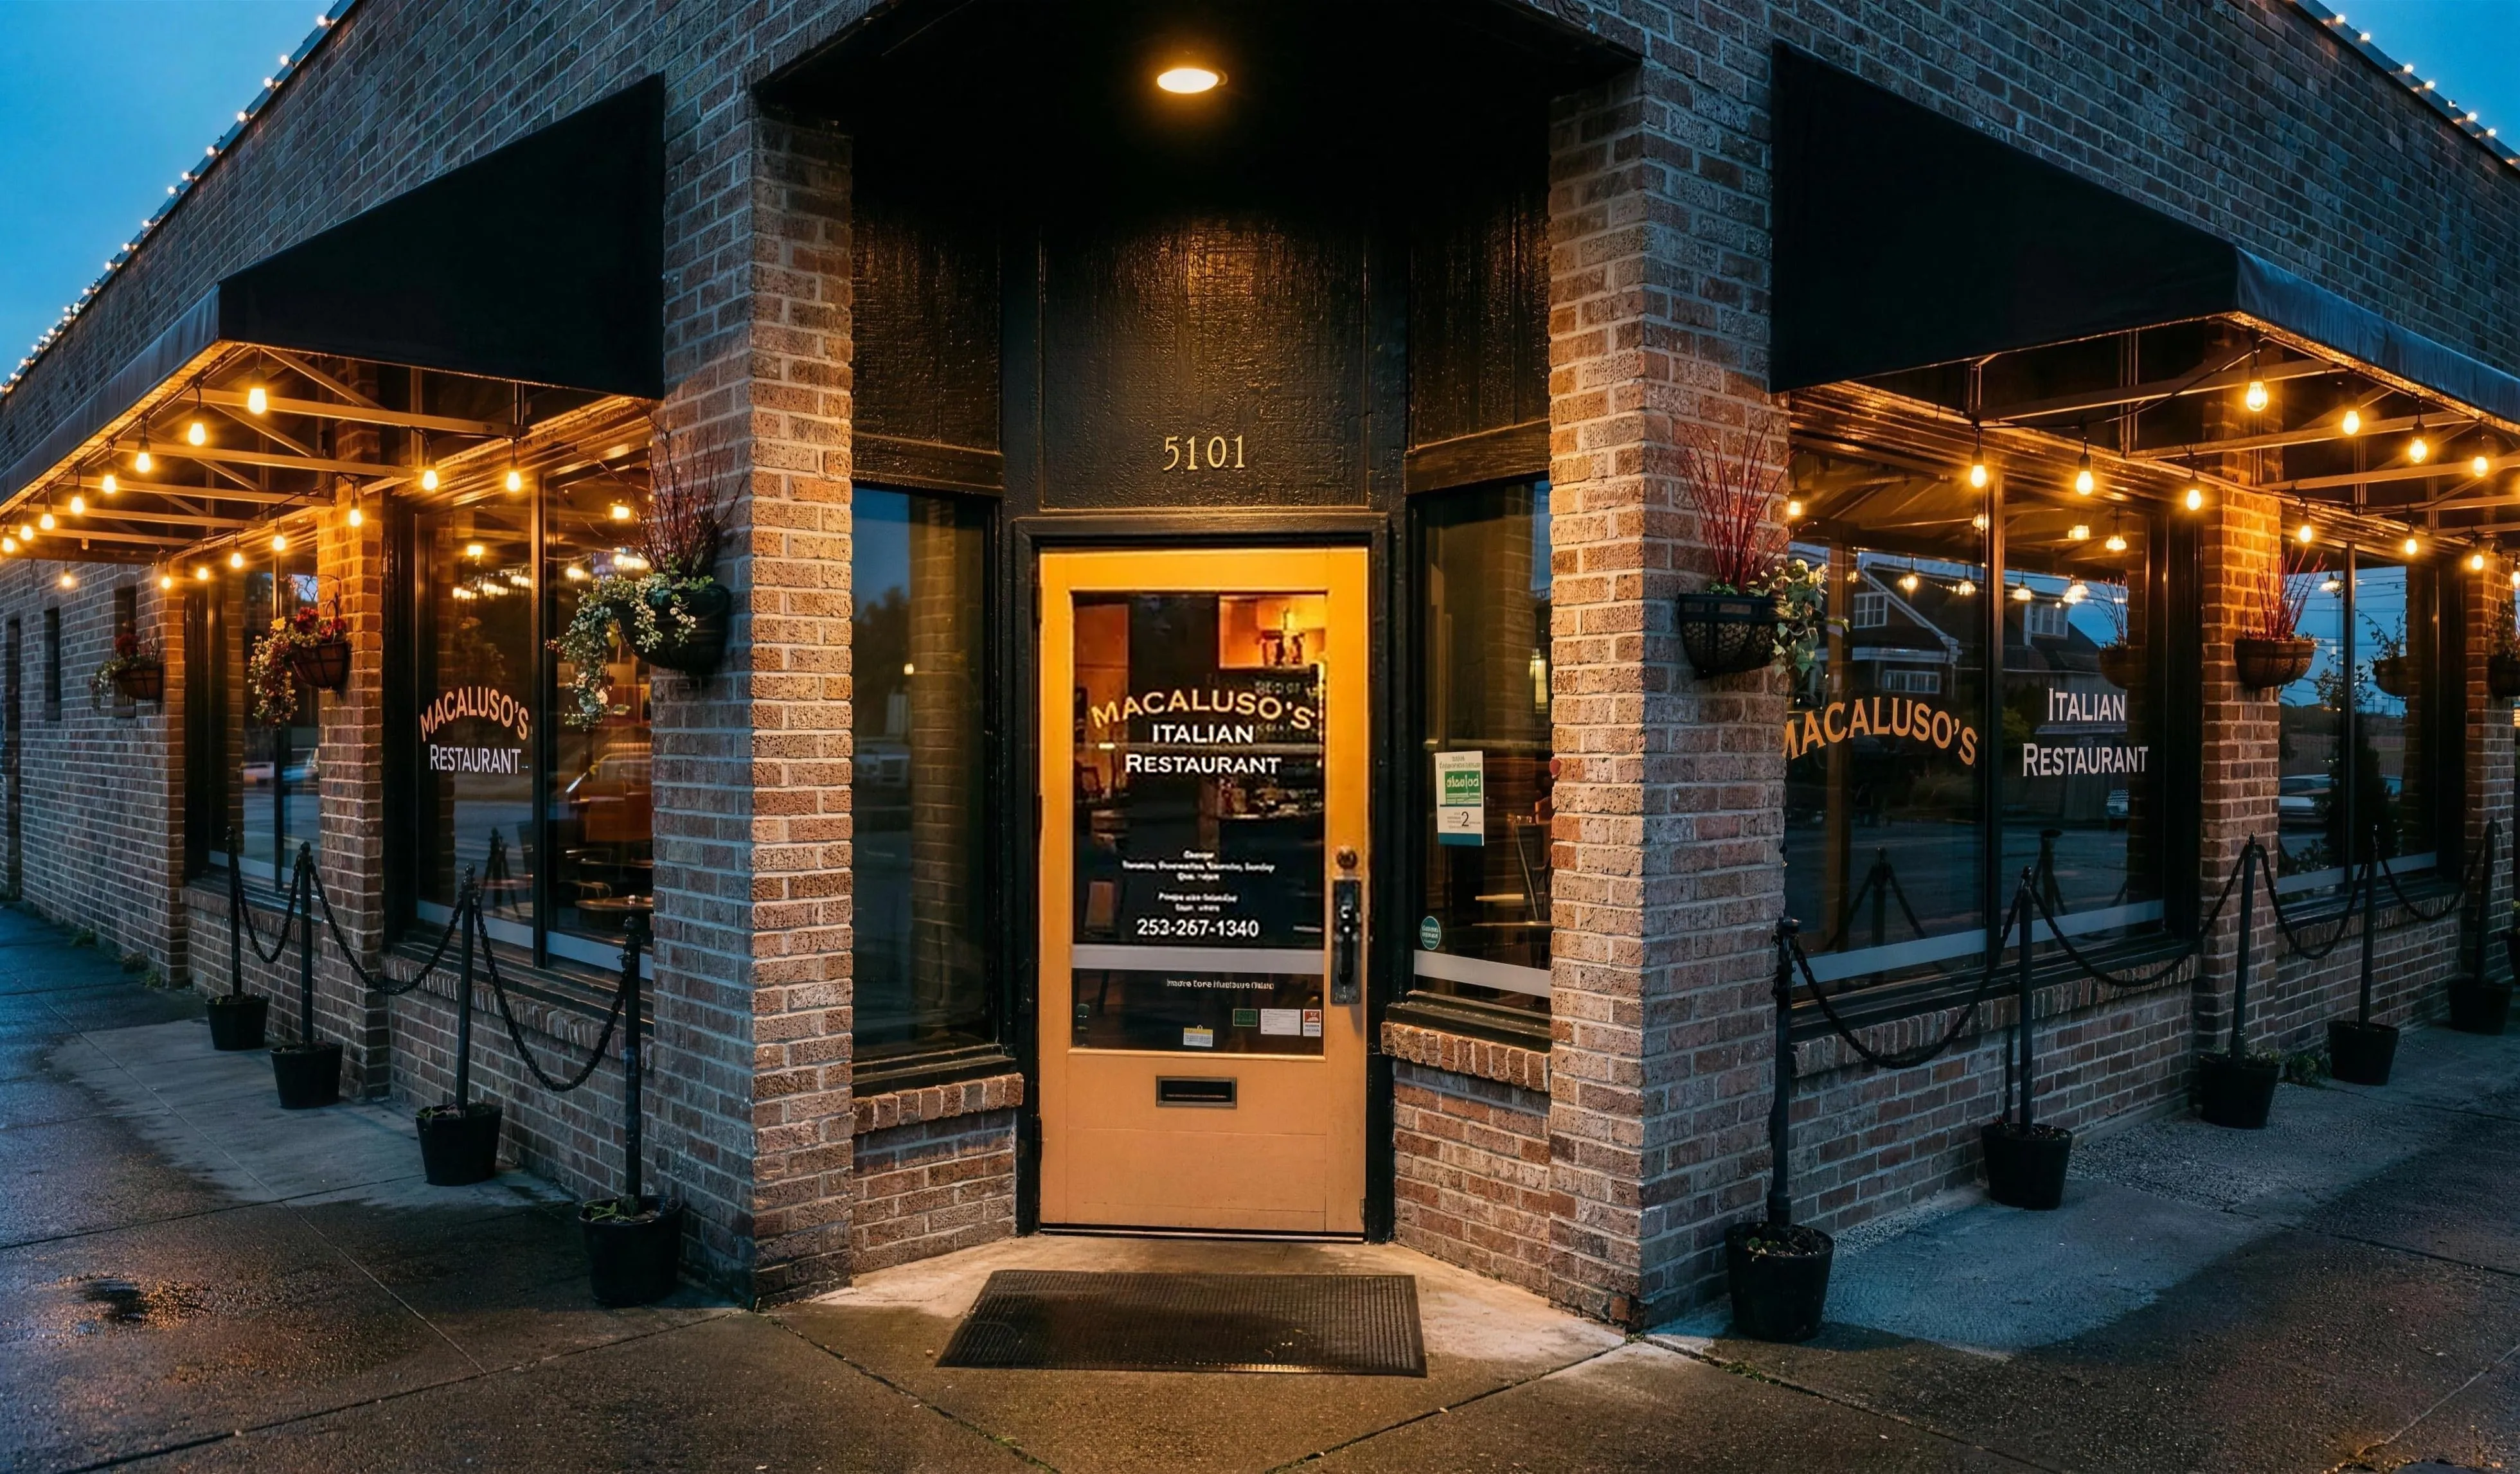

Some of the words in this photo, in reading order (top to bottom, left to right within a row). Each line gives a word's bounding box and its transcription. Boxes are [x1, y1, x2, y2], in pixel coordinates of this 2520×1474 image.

[1163, 434, 1246, 471] 5101
[420, 686, 529, 743] MACALUSO'S
[1091, 689, 1316, 730] MACALUSO'S
[2048, 687, 2127, 722] ITALIAN
[1152, 724, 1254, 744] ITALIAN
[429, 743, 522, 774] RESTAURANT
[1125, 754, 1282, 774] RESTAURANT
[2023, 743, 2149, 777] RESTAURANT
[1461, 811, 1469, 827] 2
[1136, 918, 1260, 938] 253-267-1340
